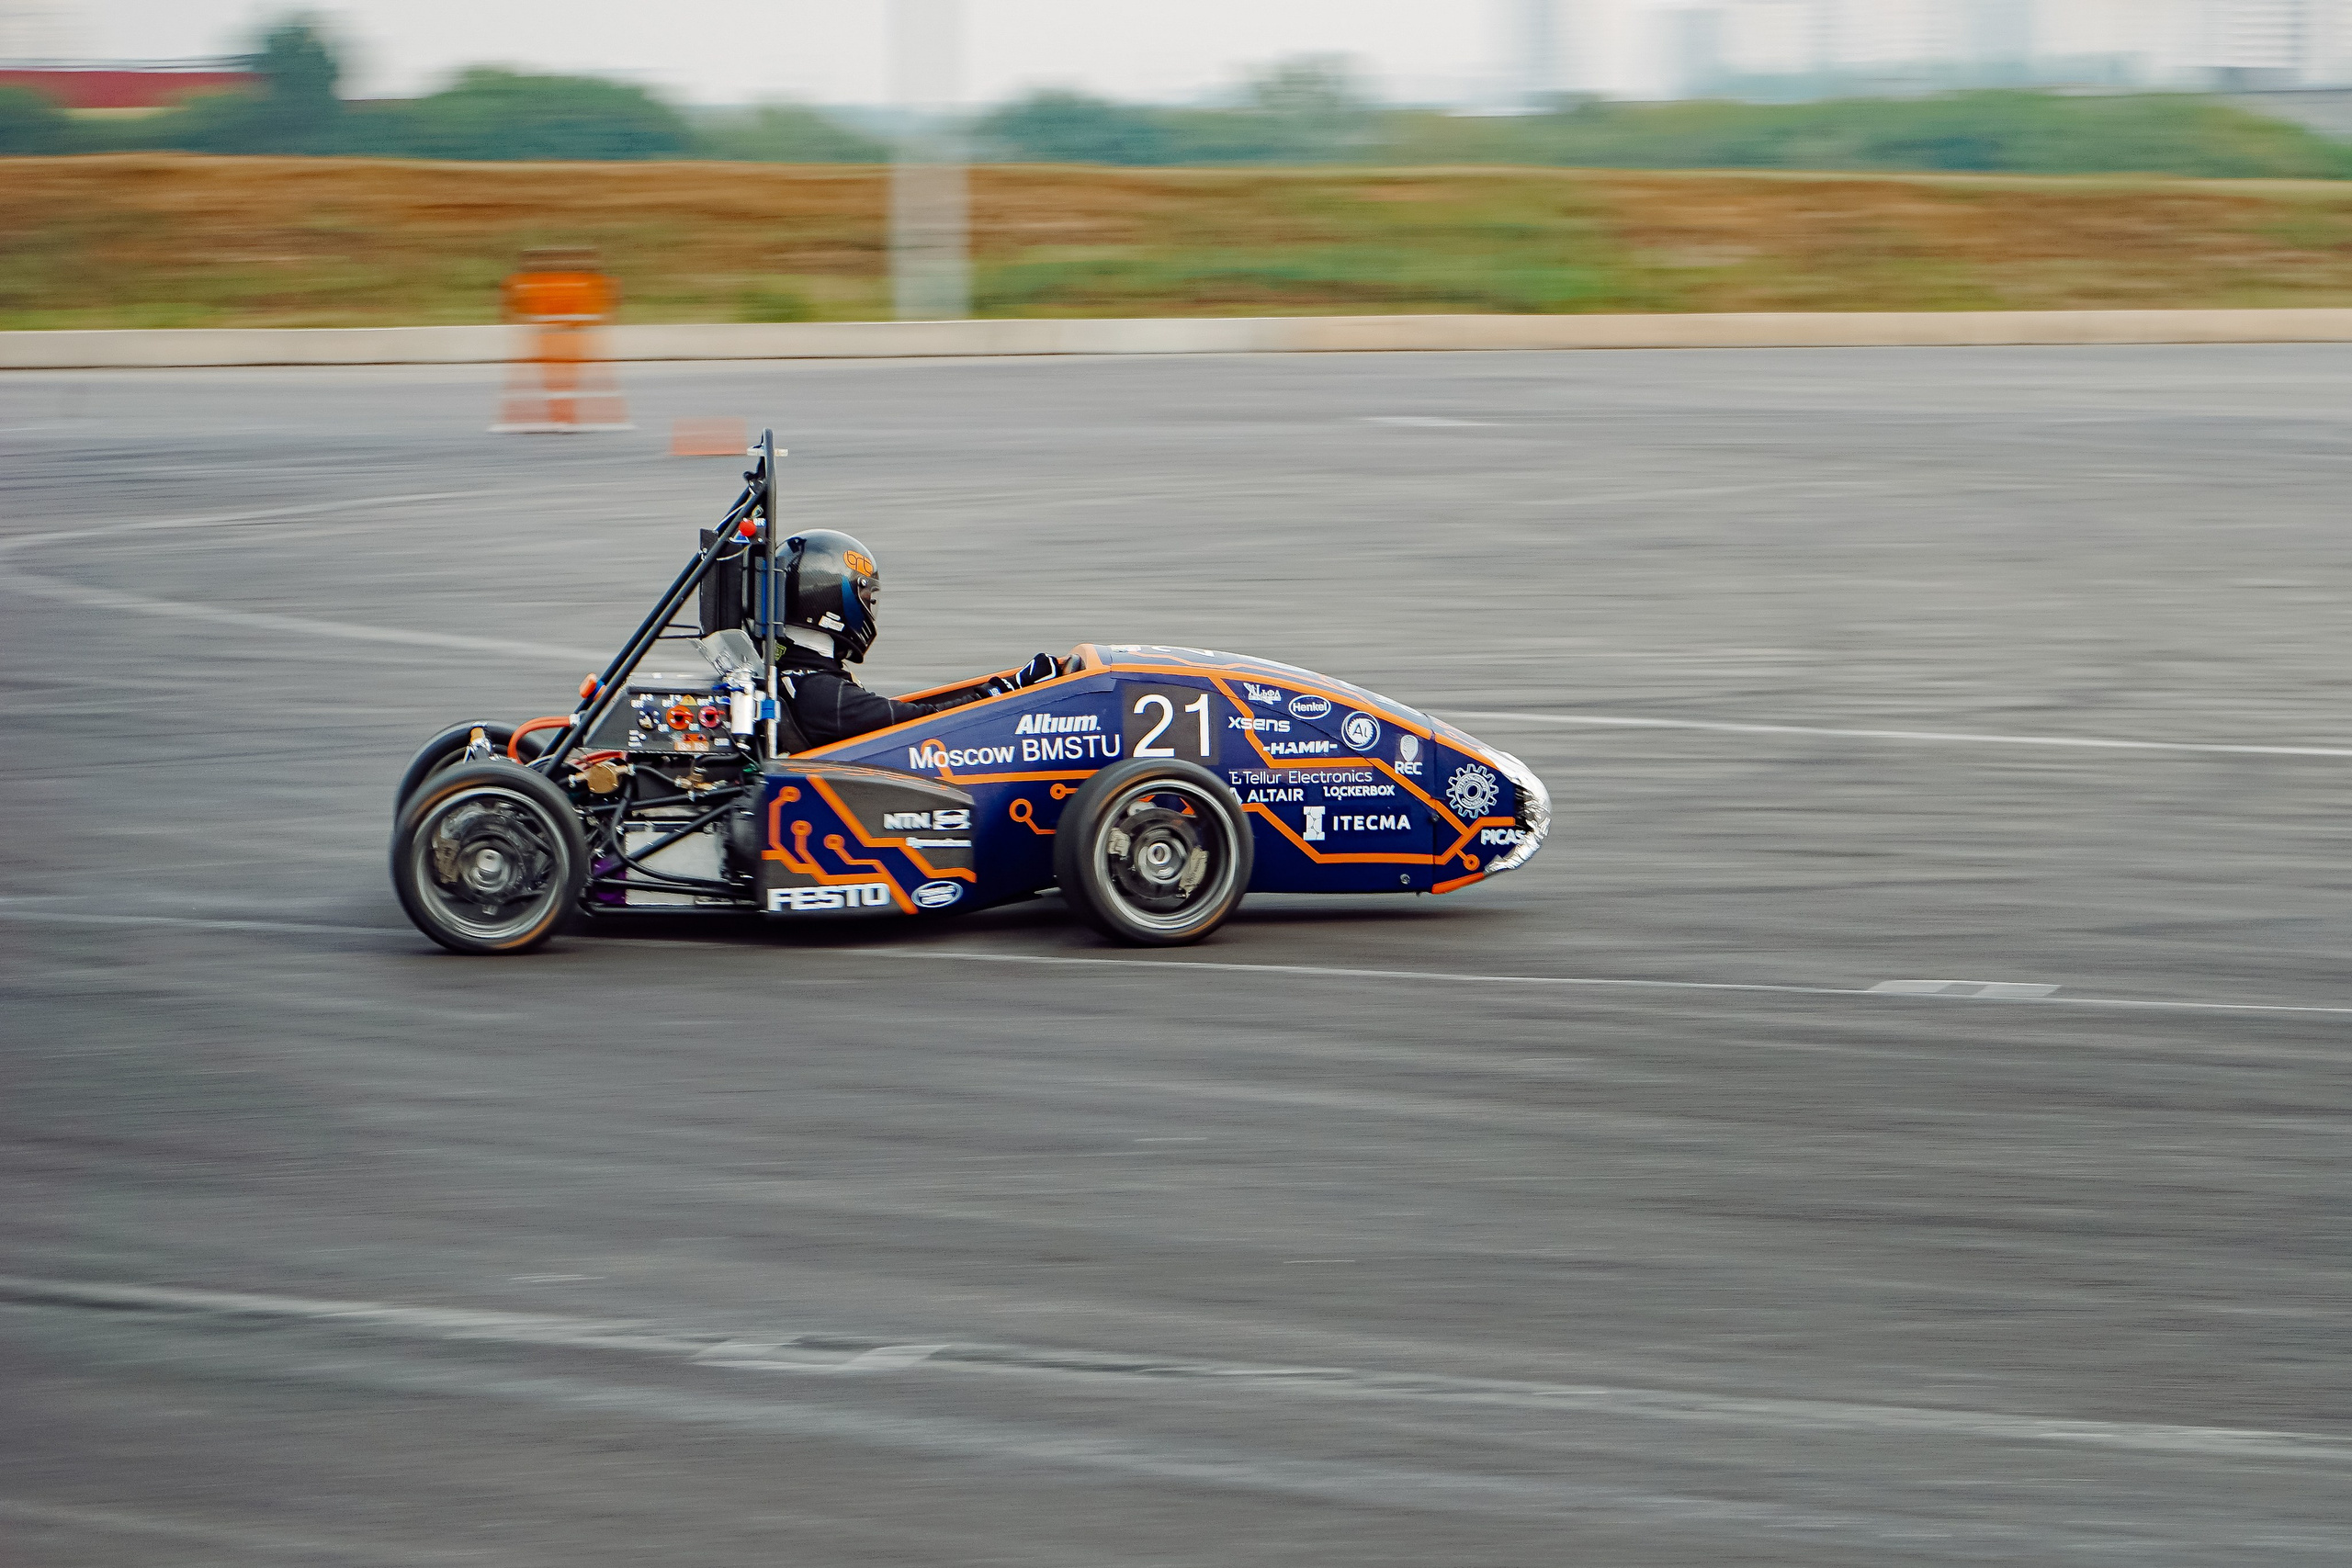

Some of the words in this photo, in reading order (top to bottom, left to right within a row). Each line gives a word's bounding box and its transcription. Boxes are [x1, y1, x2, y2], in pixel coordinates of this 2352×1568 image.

[1293, 702, 1328, 712] Henkel
[1133, 693, 1211, 758] 21
[1022, 734, 1121, 762] BMSTU
[1395, 761, 1423, 775] REC
[1243, 771, 1282, 784] Tellur
[1288, 770, 1373, 784] Electronics
[1247, 788, 1305, 803] ALTAIR
[884, 812, 931, 829] NTN
[1333, 815, 1411, 830] ITECMA
[767, 883, 890, 911] FESTO
